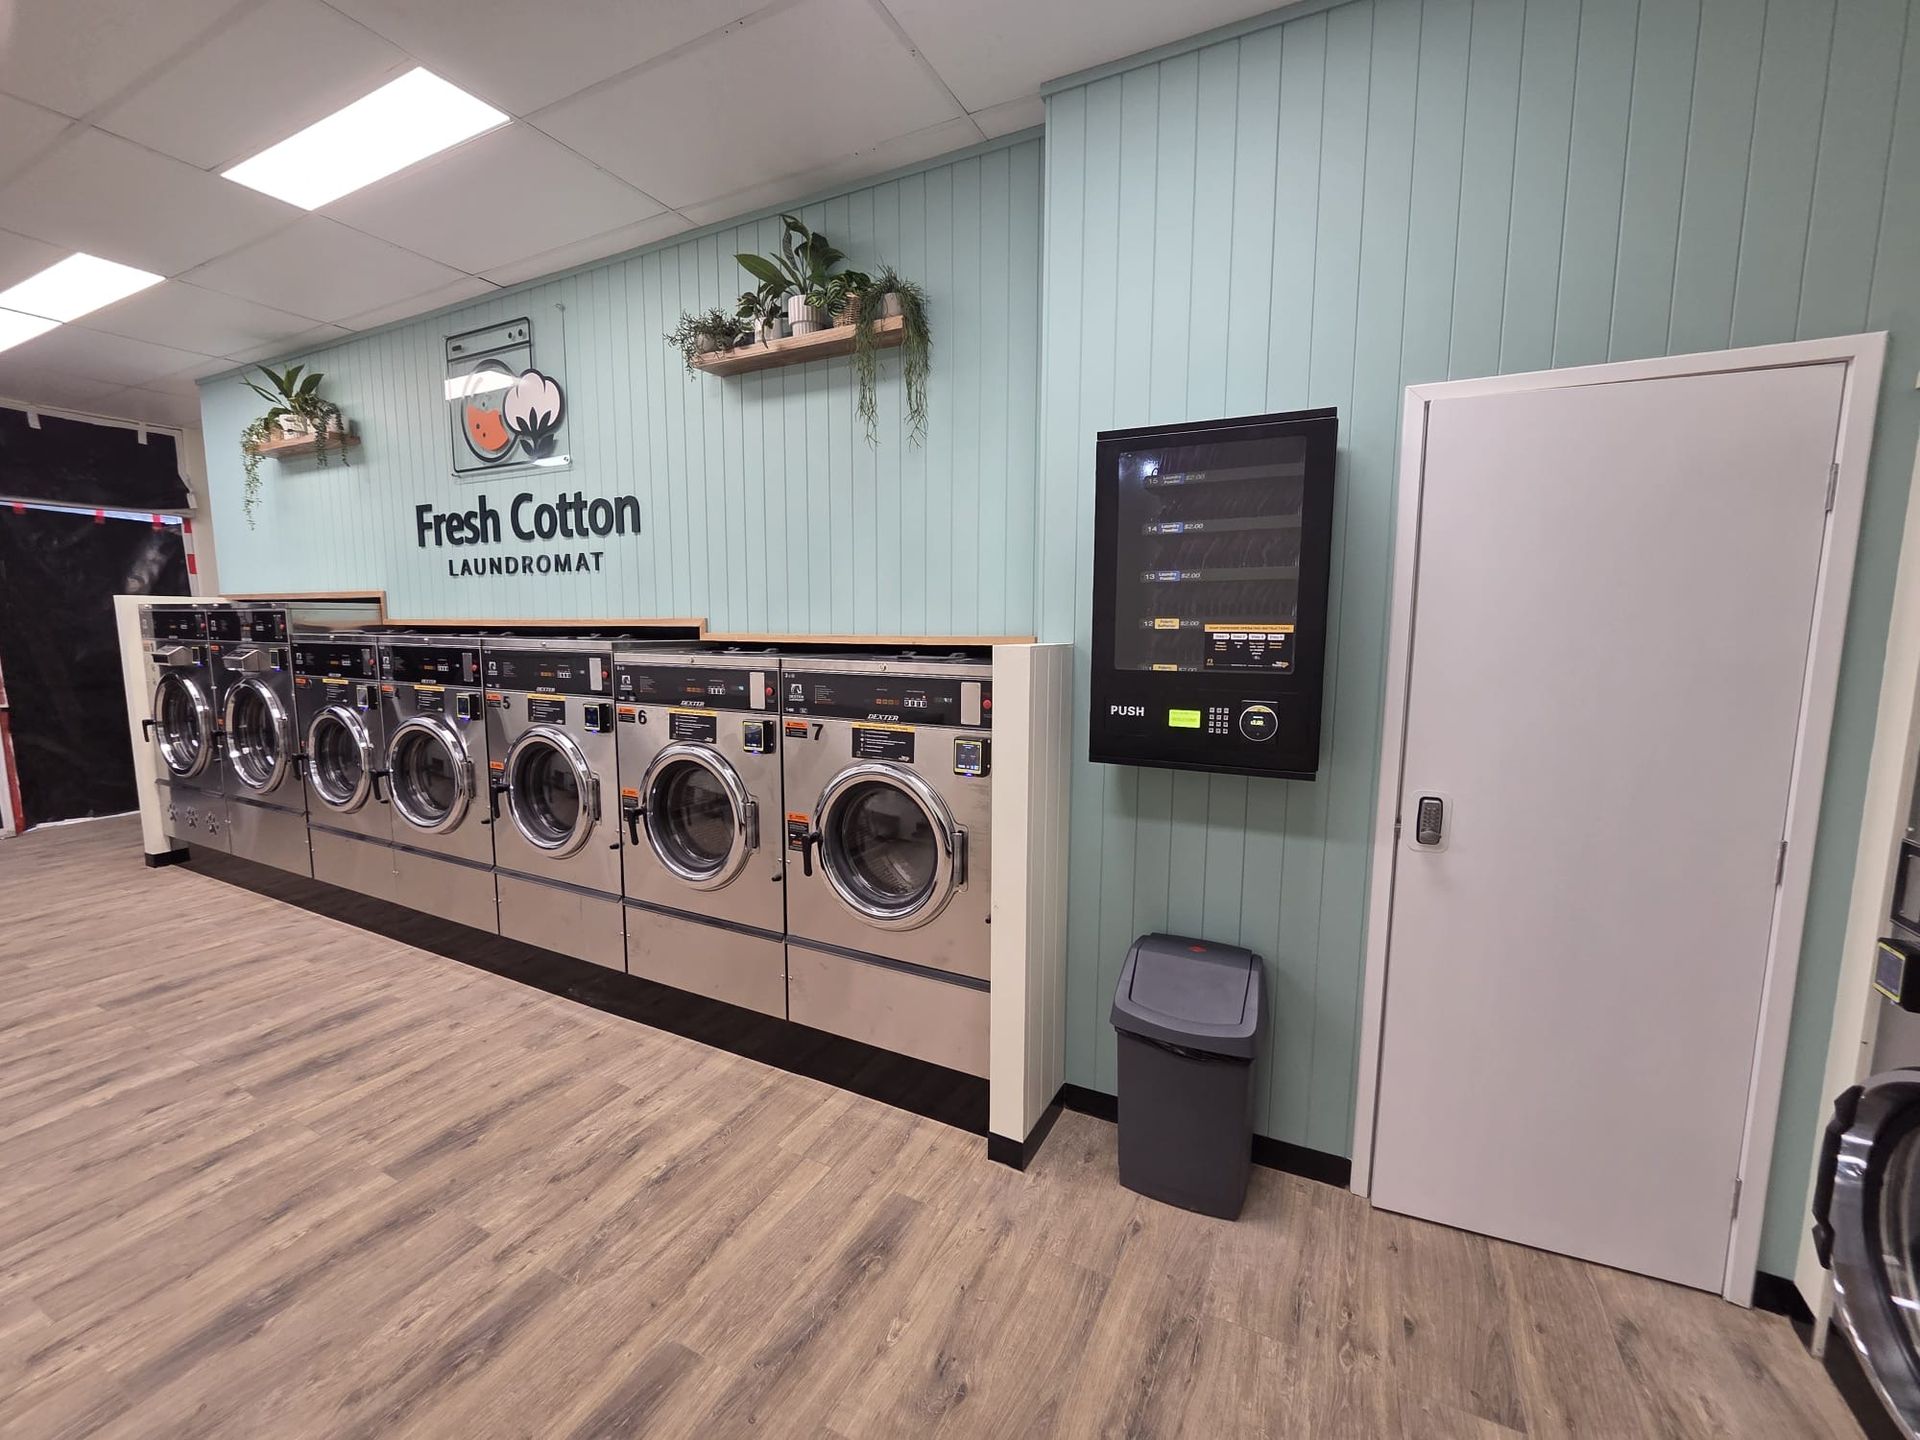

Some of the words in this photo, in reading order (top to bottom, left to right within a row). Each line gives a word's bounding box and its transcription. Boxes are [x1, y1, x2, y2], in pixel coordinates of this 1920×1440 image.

[415, 494, 502, 547] Fresh
[511, 491, 641, 541] Cotton
[448, 551, 604, 577] LAUNDROMAT
[503, 695, 511, 710] 5
[680, 699, 705, 708] DEXTER
[637, 709, 648, 725] 6
[867, 712, 900, 722] DEXTER
[1110, 705, 1145, 717] PUSH
[812, 723, 824, 741] 7
